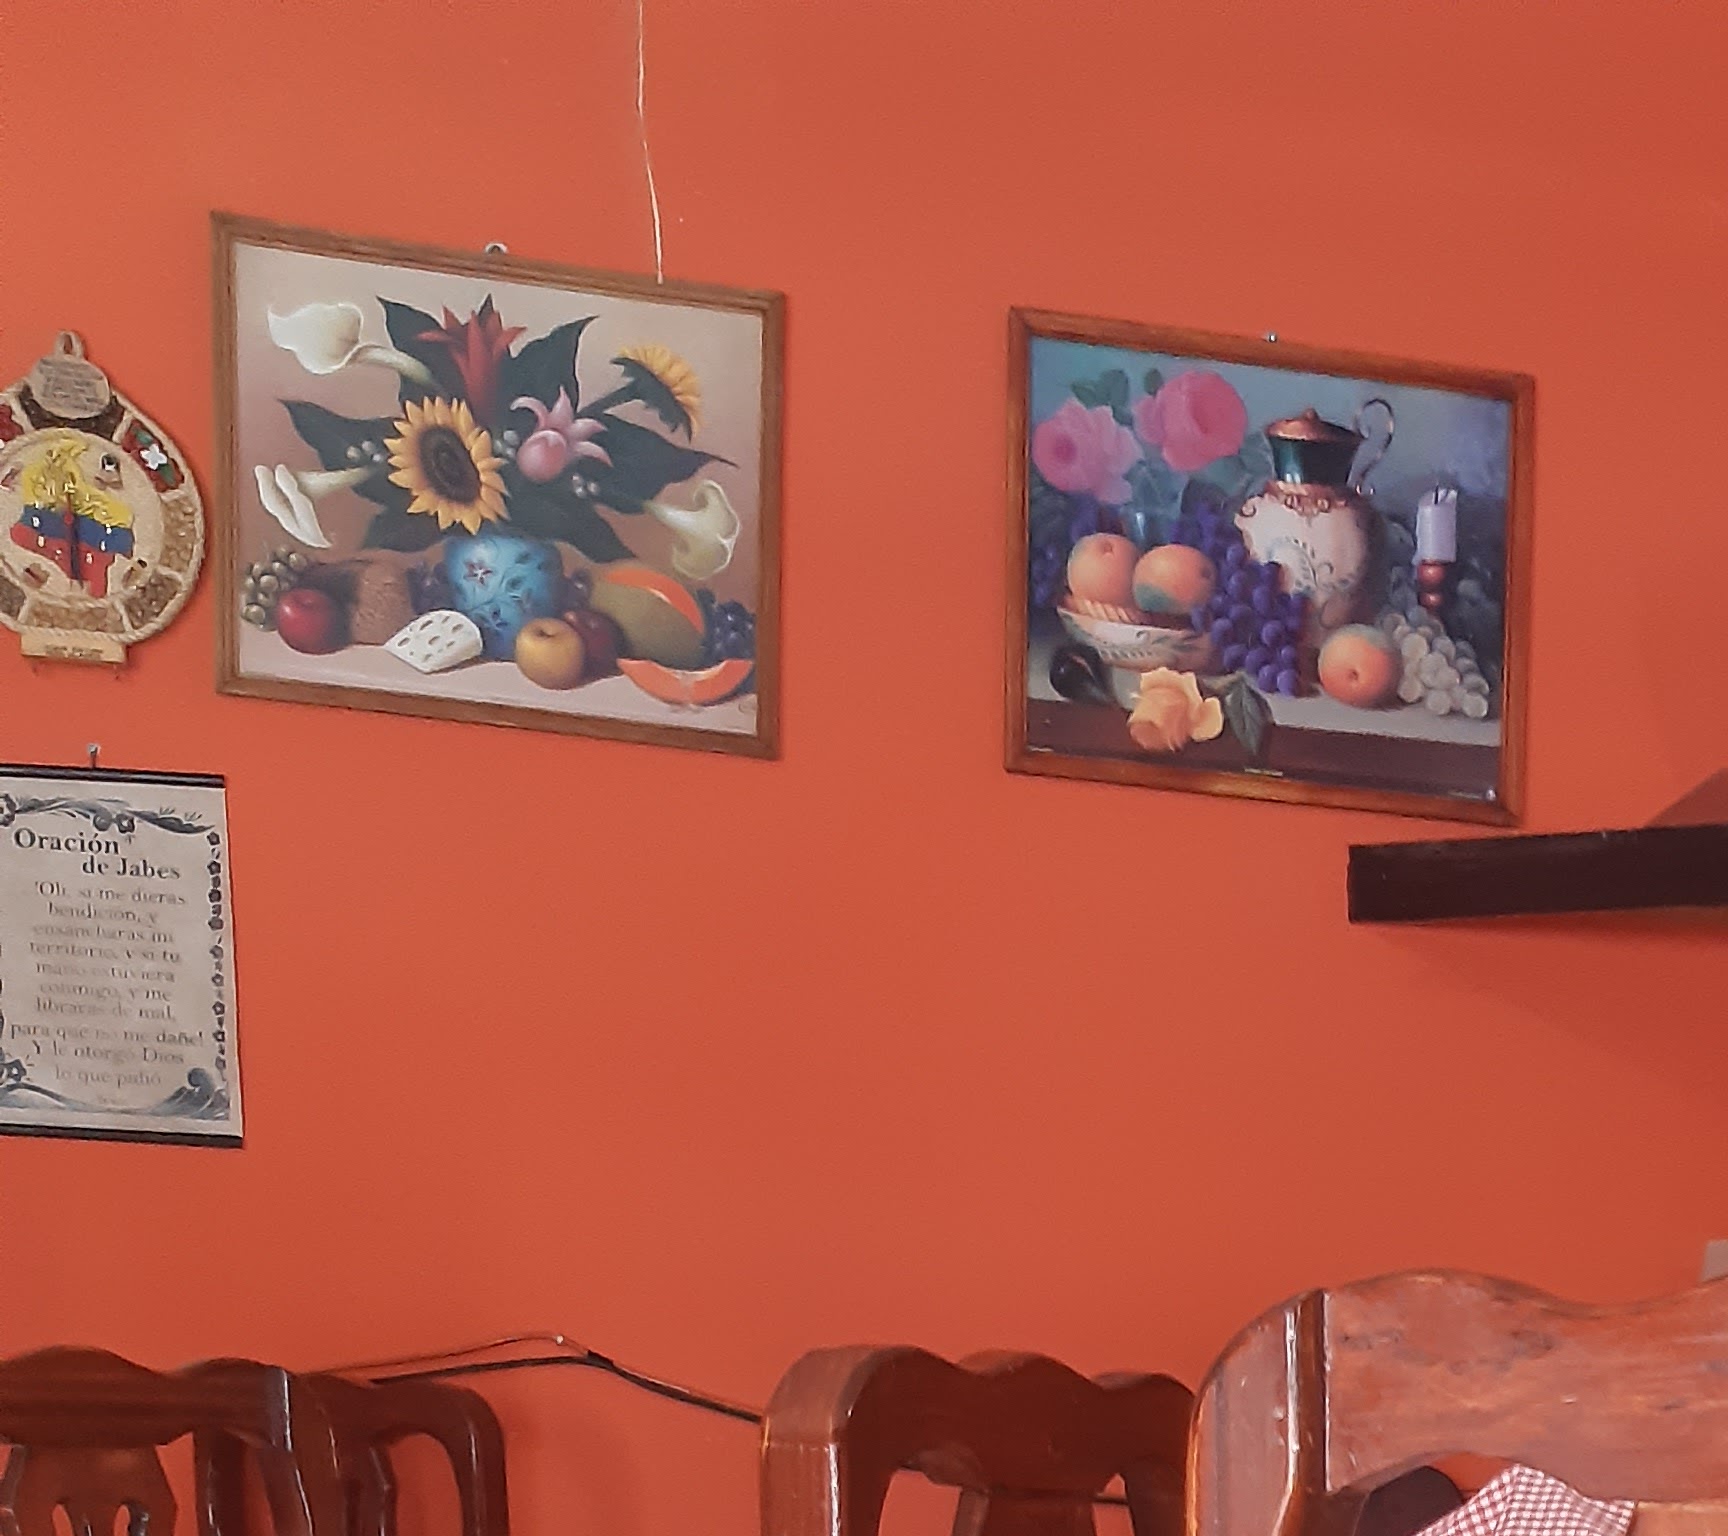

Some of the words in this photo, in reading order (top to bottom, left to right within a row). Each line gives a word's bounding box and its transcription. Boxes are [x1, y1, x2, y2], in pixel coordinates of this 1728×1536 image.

[14, 827, 119, 855] Oración
[82, 855, 109, 875] de
[117, 858, 181, 880] Jabes
